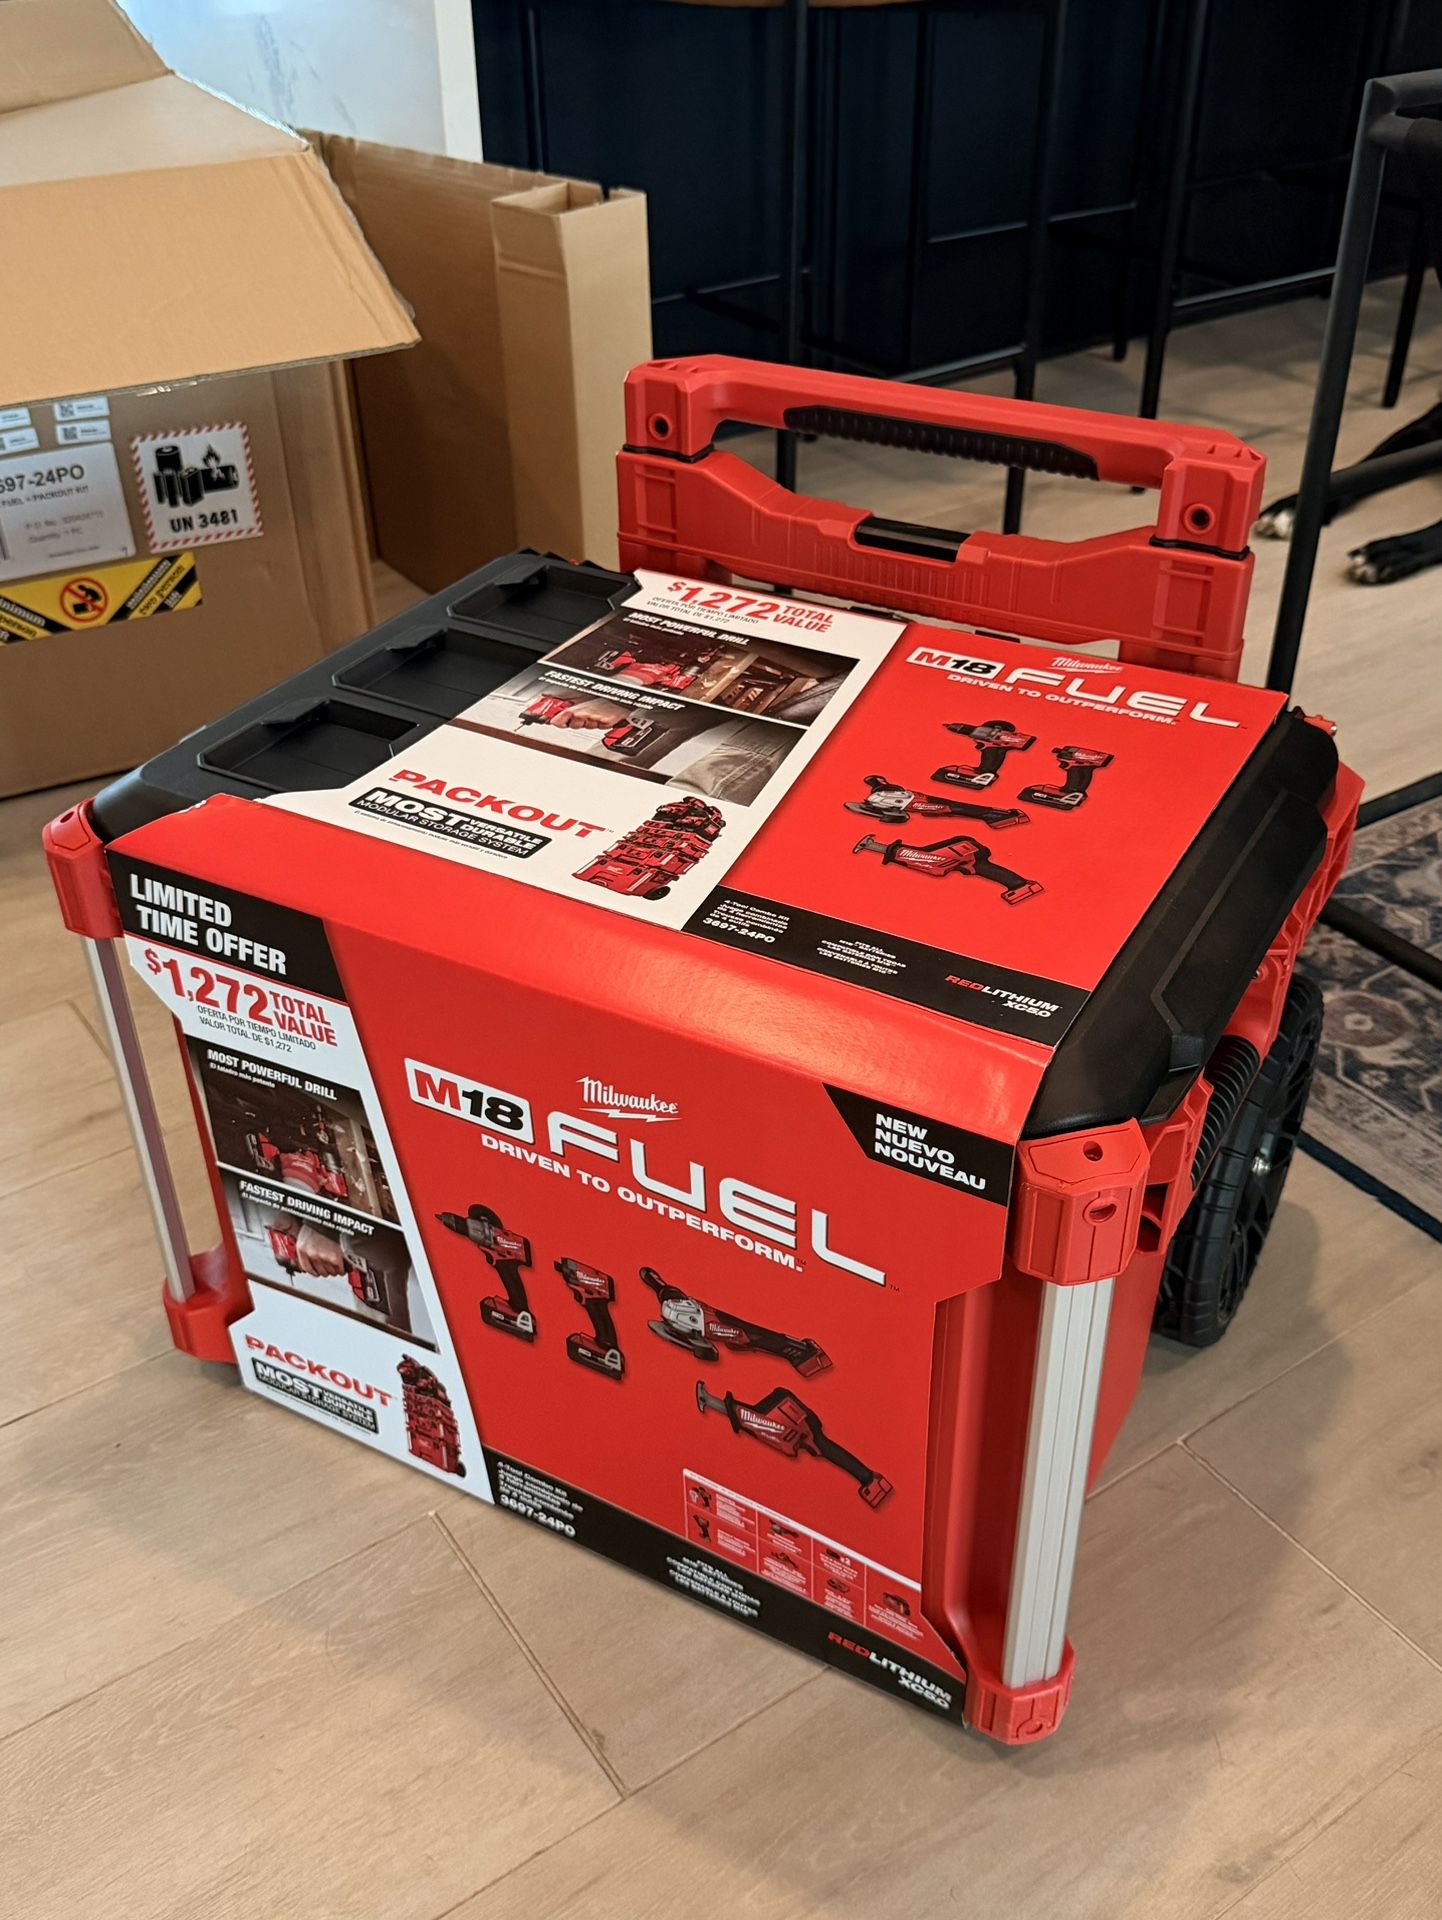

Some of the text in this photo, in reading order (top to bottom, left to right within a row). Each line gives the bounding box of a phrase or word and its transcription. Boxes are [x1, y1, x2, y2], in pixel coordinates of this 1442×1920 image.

[170, 509, 238, 533] UN 3481
[0, 598, 46, 627] nimum
[667, 581, 834, 624] $1,272 TOTAL
[773, 613, 832, 633] VALUE
[628, 612, 662, 623] MOST
[660, 619, 718, 638] POWERFUL
[717, 633, 750, 645] DRILL
[947, 673, 1013, 693] DRIVEN
[1017, 688, 1041, 698] TO
[1049, 657, 1124, 673] Milwaukee
[544, 670, 597, 688] FASTEST
[591, 682, 641, 700] DRIVING
[638, 694, 686, 711] IMPACT
[917, 652, 1240, 728] M18 FUEL
[365, 790, 543, 845] MOST VERSATILE
[388, 769, 606, 838] PACKOUT
[357, 800, 418, 822] MODULAR
[419, 819, 478, 840] STORAGE
[478, 836, 529, 856] SYSTEM
[459, 824, 537, 850] DURABLE
[900, 850, 946, 862] Milwaukee
[130, 873, 232, 927] LIMITED
[136, 904, 287, 975] TIME OFFER
[702, 917, 775, 943] 3697-24PO
[144, 948, 332, 1025] $1,272 TOTAL
[945, 974, 1059, 1012] REDLITHIUM
[197, 1005, 316, 1050] OFERTA POR TIEMPO LIMITADO
[199, 1016, 225, 1032] VALOR
[226, 1024, 250, 1039] TOTAL
[252, 1032, 263, 1043] DE
[273, 1011, 338, 1047] VALUE
[207, 1049, 337, 1100] MOST POWERFUL DRILL
[576, 1076, 679, 1114] Milwaukee
[875, 1127, 955, 1165] NUEVO
[876, 1113, 928, 1140] NEW
[414, 1068, 885, 1286] M18 FUEL
[481, 1133, 571, 1178] DRIVEN
[577, 1169, 611, 1192] TO
[875, 1141, 986, 1190] NOUVEAU
[240, 1180, 375, 1236] FASTEST DRIVING IMPACT
[245, 1334, 392, 1407] PACKOUT
[256, 1361, 322, 1399] MOST
[322, 1389, 373, 1417] VERSATILE
[260, 1375, 301, 1399] MODULAR
[302, 1392, 340, 1415] STORAGE
[342, 1411, 376, 1431] SYSTEM
[323, 1396, 374, 1423] DURABLE
[740, 1408, 785, 1430] Milwaukee
[500, 1494, 576, 1537] 3697-24PO
[827, 1631, 952, 1703] REDLITHIUM
